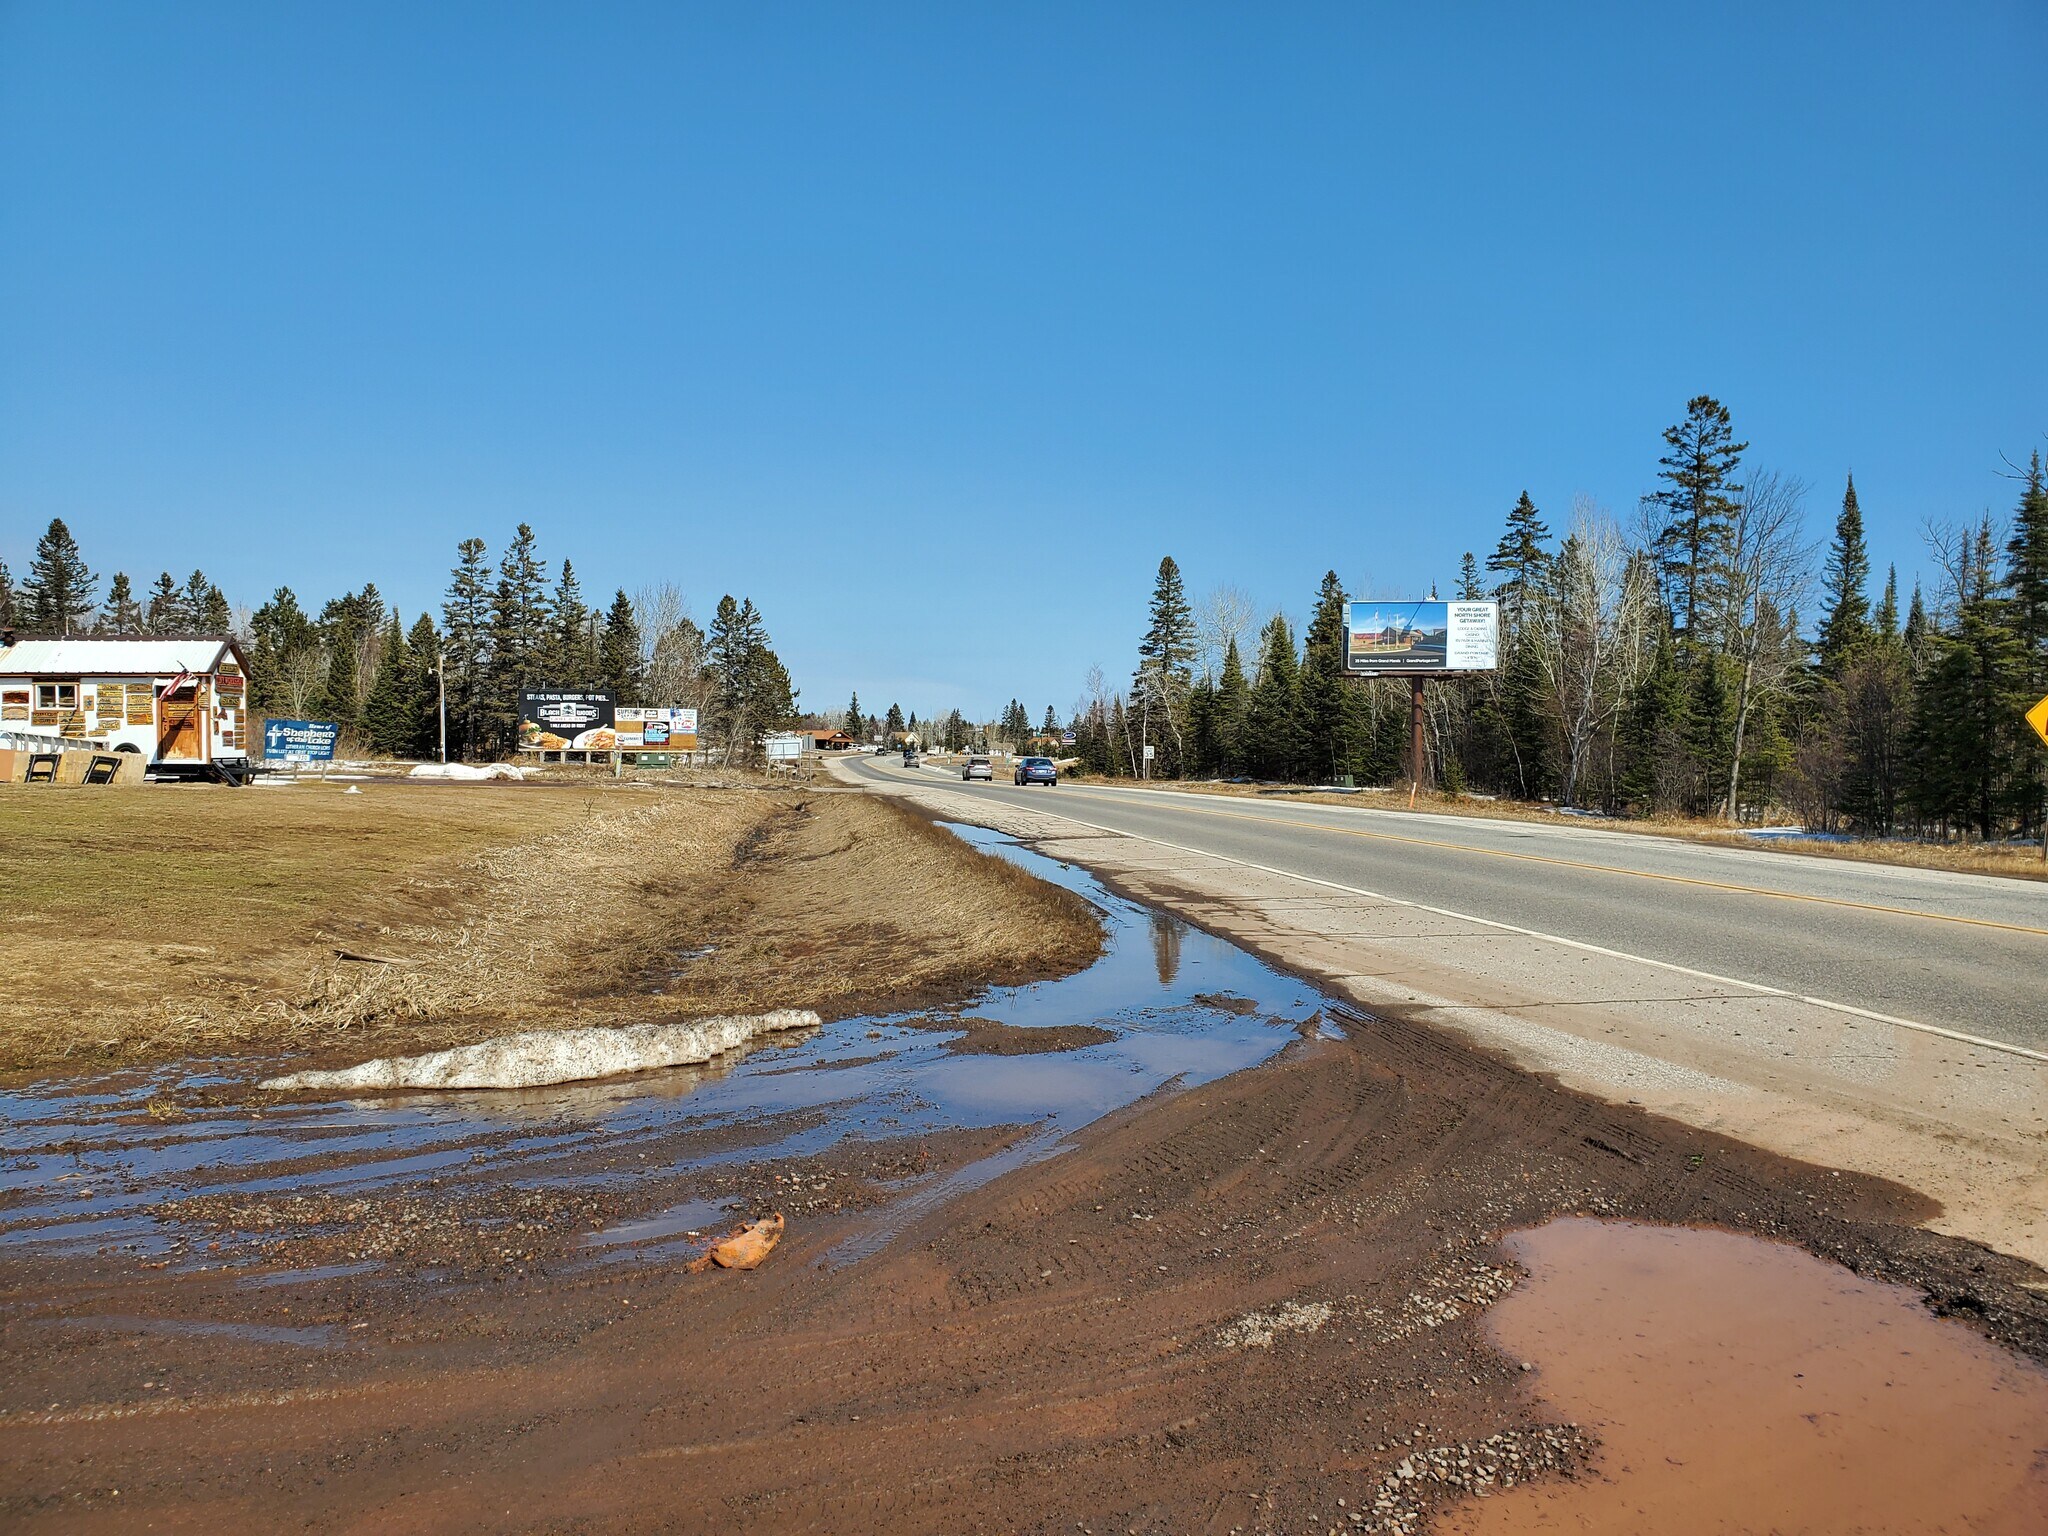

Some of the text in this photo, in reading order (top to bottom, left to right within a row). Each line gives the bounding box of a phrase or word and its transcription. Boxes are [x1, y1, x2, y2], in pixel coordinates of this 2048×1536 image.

[617, 708, 642, 716] SUPERIOR
[282, 727, 335, 738] Shepherd
[307, 736, 331, 745] Lake
